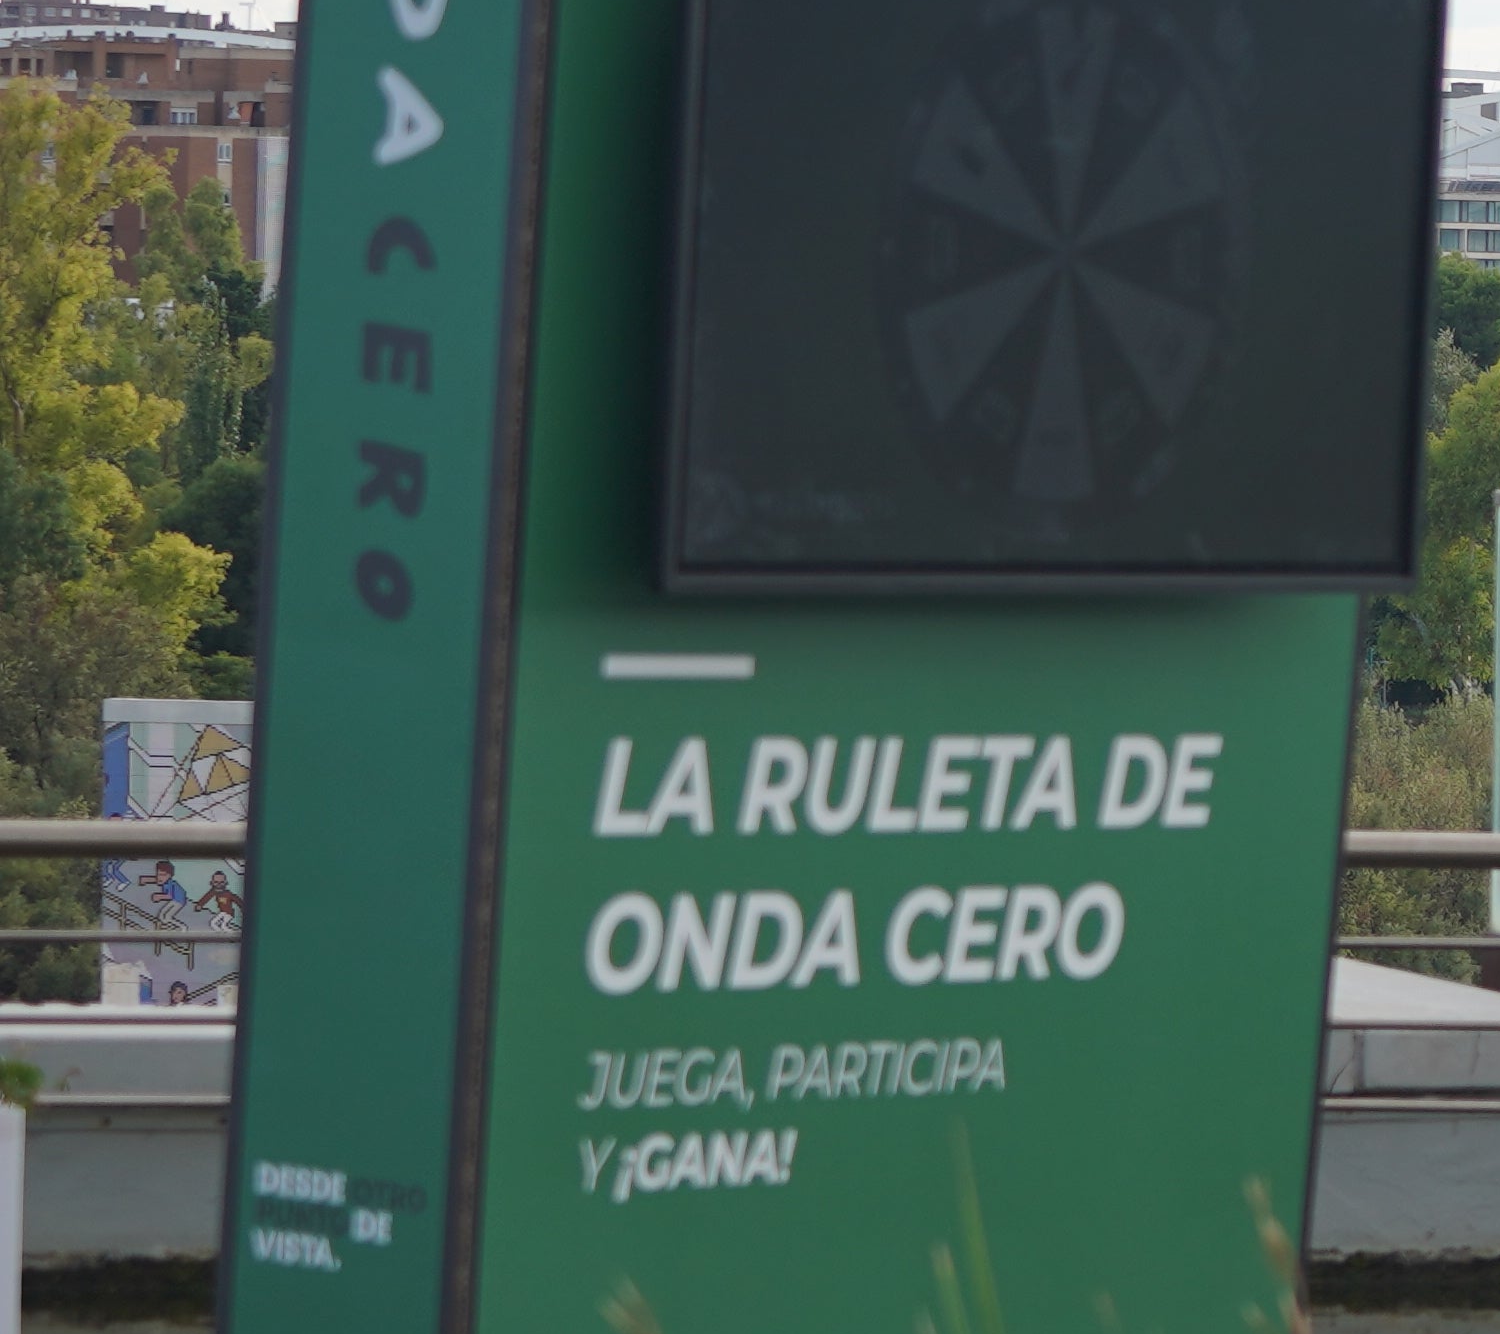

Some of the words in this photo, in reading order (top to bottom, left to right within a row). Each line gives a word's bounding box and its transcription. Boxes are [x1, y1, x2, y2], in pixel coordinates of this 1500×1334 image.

[353, 214, 437, 622] CERO
[593, 735, 714, 838] LA
[736, 733, 1078, 836] RULETA
[1097, 732, 1224, 831] DE
[585, 886, 861, 996] ONDA
[885, 881, 1125, 986] CERO
[577, 1047, 755, 1112] JUEGA,
[765, 1037, 1005, 1100] PARTICIPA
[252, 1160, 348, 1206] DESDE
[579, 1136, 617, 1195] Y
[612, 1127, 798, 1204] ¡GANA!
[350, 1208, 393, 1246] DE
